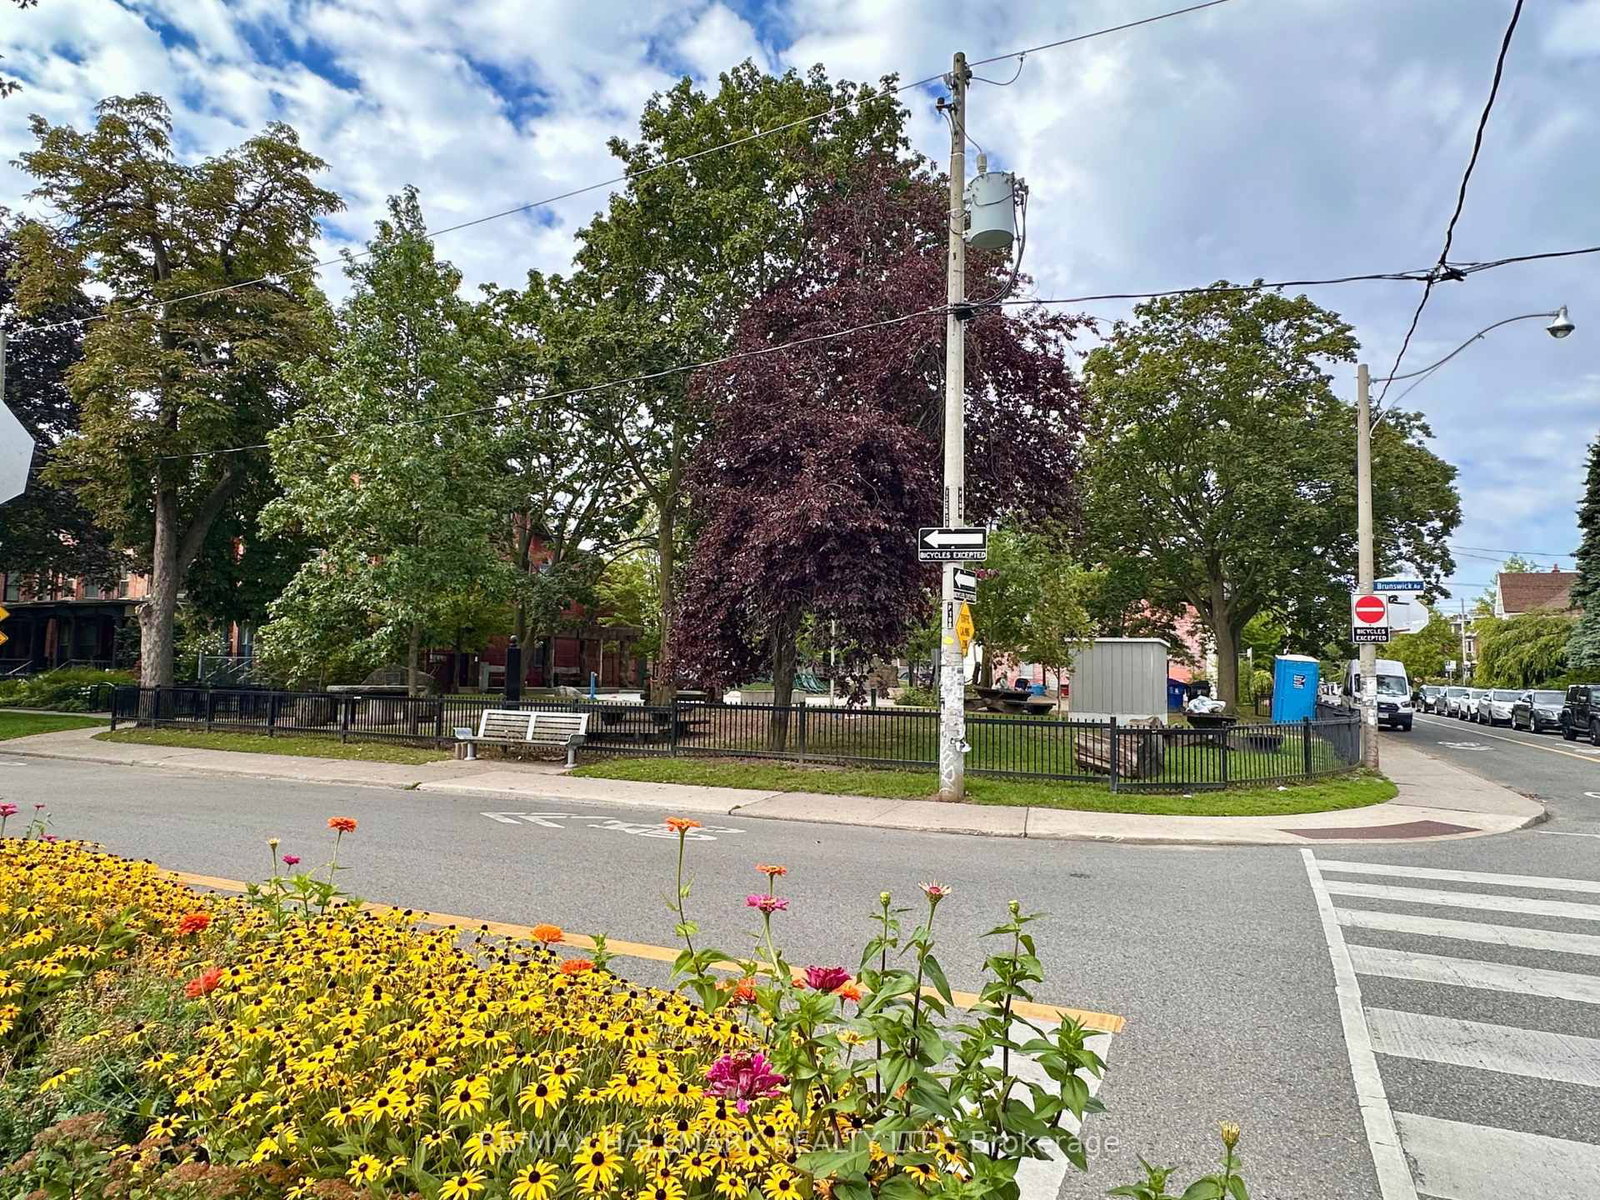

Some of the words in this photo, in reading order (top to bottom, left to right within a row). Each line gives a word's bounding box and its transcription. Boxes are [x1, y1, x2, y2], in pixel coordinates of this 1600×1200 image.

[920, 551, 951, 559] BICYCLES
[953, 551, 986, 559] EXCEPTED
[1376, 582, 1412, 590] Brunswick
